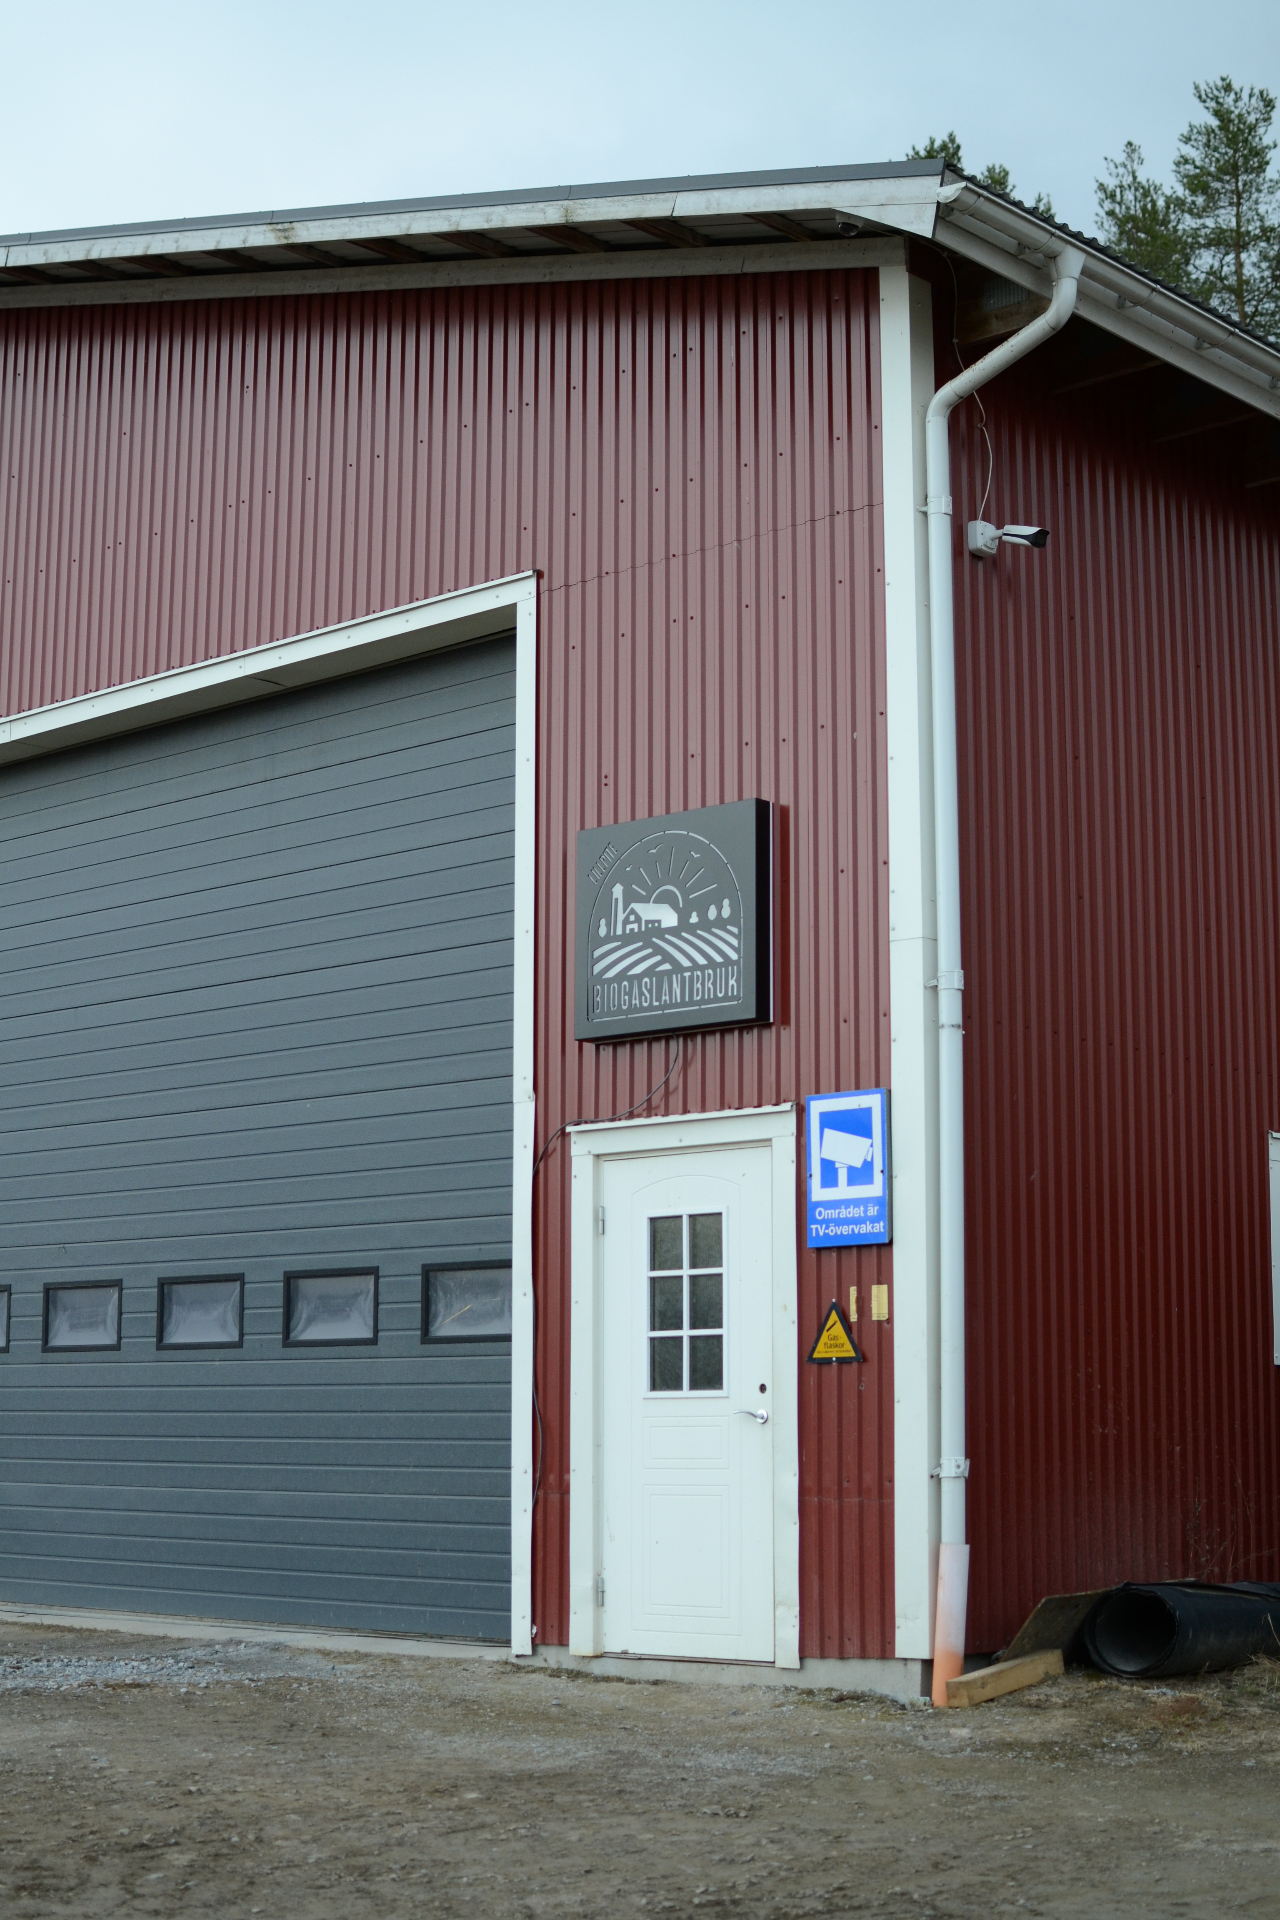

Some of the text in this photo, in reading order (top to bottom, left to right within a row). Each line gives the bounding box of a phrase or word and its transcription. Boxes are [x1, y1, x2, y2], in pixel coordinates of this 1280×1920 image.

[588, 842, 618, 884] LILLPITE
[593, 966, 737, 1013] BIOGASLANTBRUK
[815, 1203, 879, 1220] Området är
[810, 1220, 885, 1237] TV-övervakat
[823, 1341, 845, 1349] flaskor
